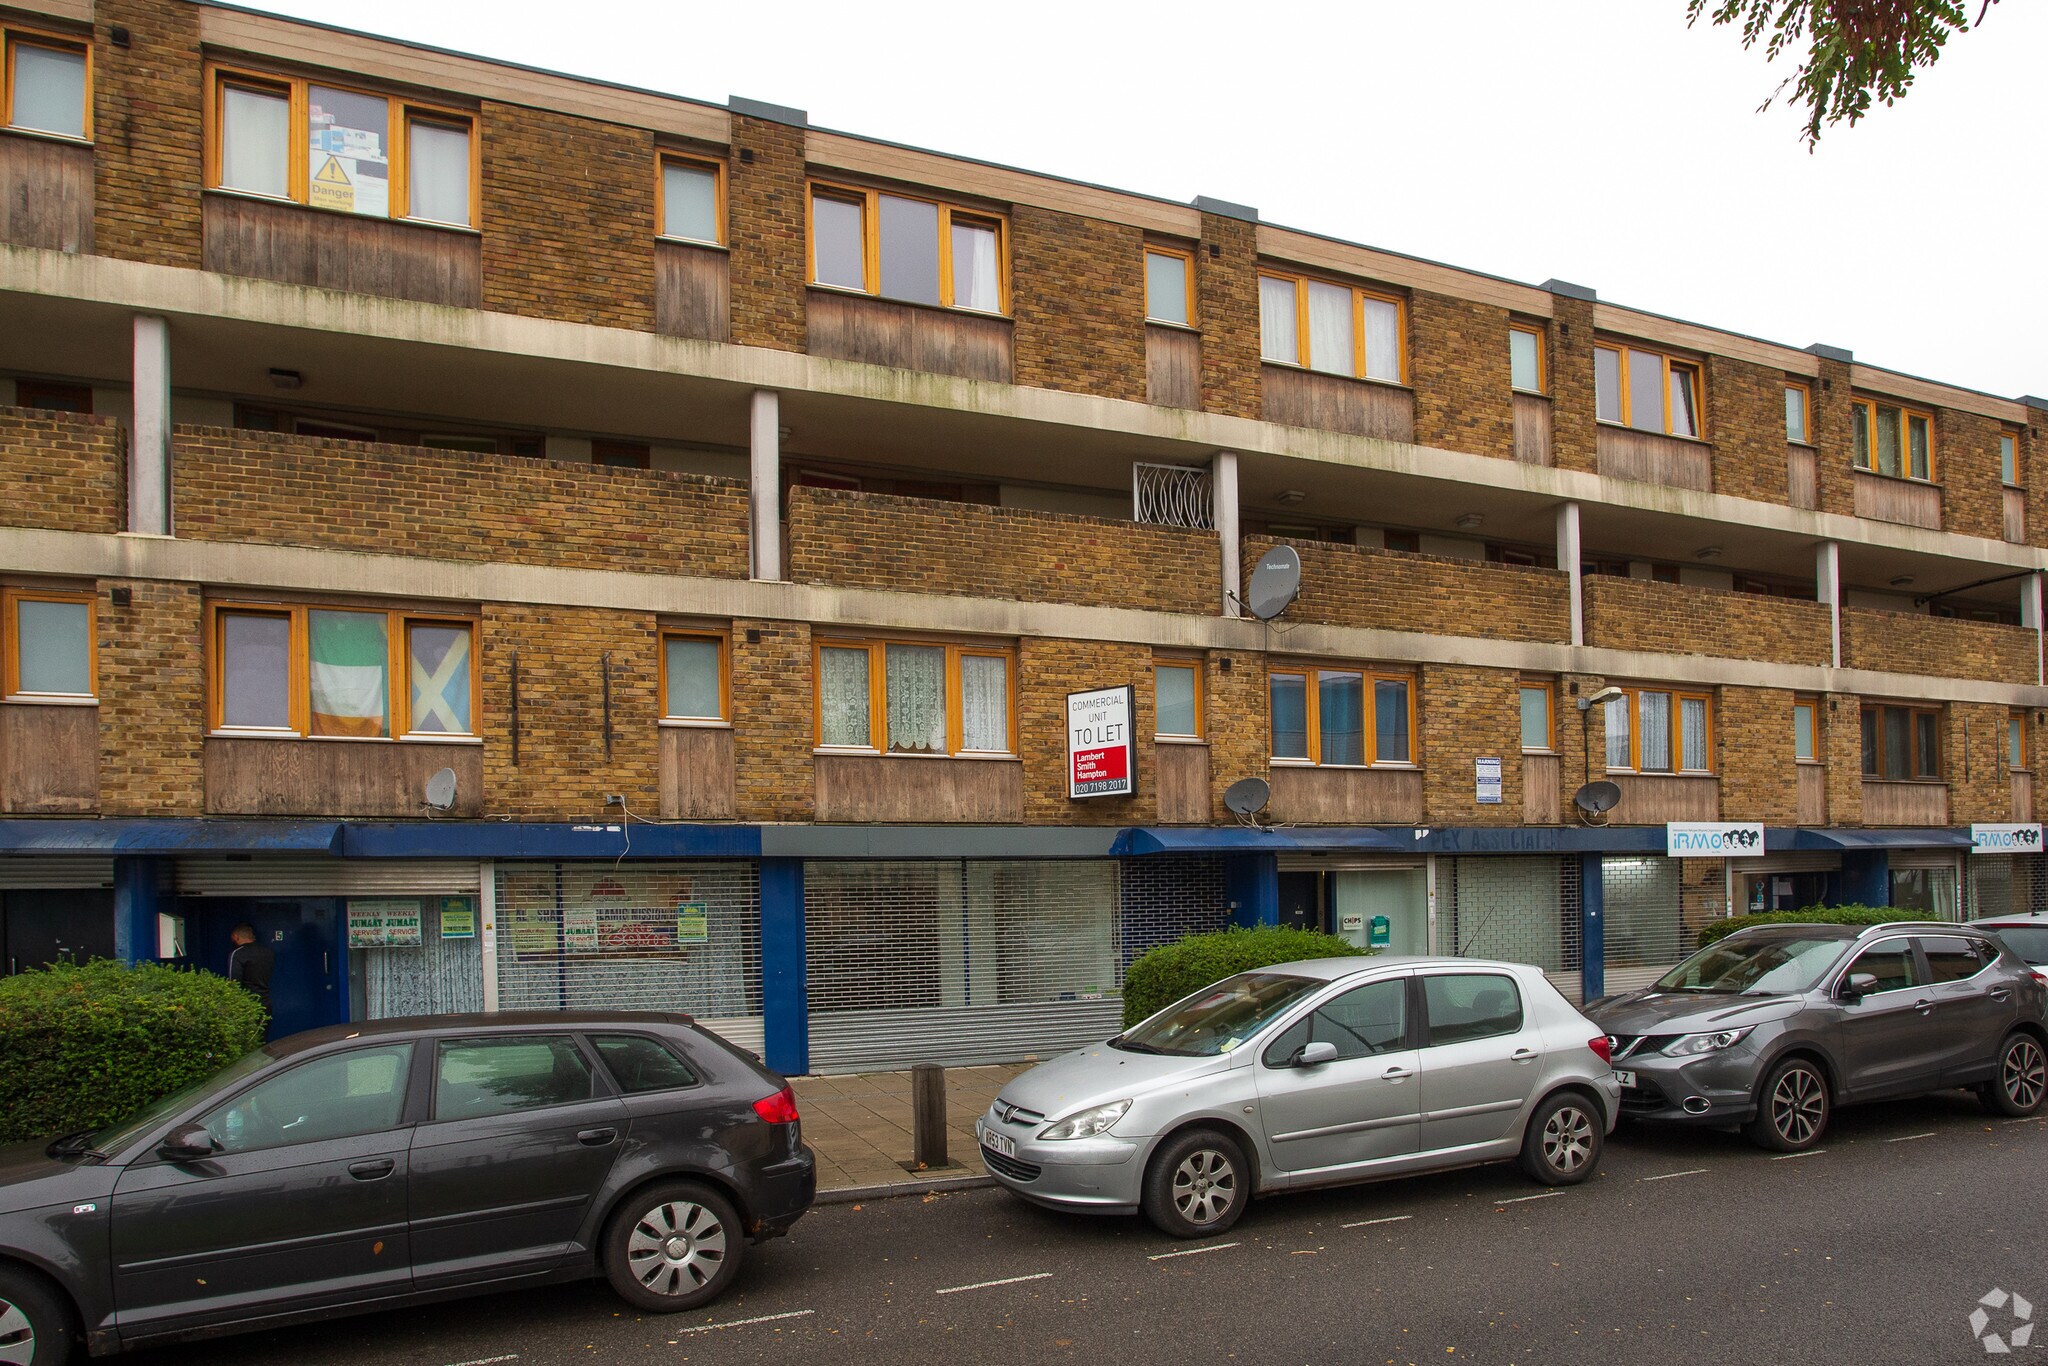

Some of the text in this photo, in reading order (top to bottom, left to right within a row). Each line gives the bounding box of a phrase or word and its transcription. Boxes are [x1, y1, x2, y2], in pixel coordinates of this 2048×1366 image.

[312, 184, 354, 199] Danger
[1072, 694, 1124, 711] COMMERCIAL
[1088, 711, 1107, 723] UNIT
[1075, 723, 1123, 745] TO LET
[1077, 752, 1105, 762] Lambert
[1077, 761, 1096, 771] Smith
[1077, 769, 1107, 780] Hampton
[1075, 779, 1127, 793] 020 7198 2017
[353, 928, 381, 936] SERVICE
